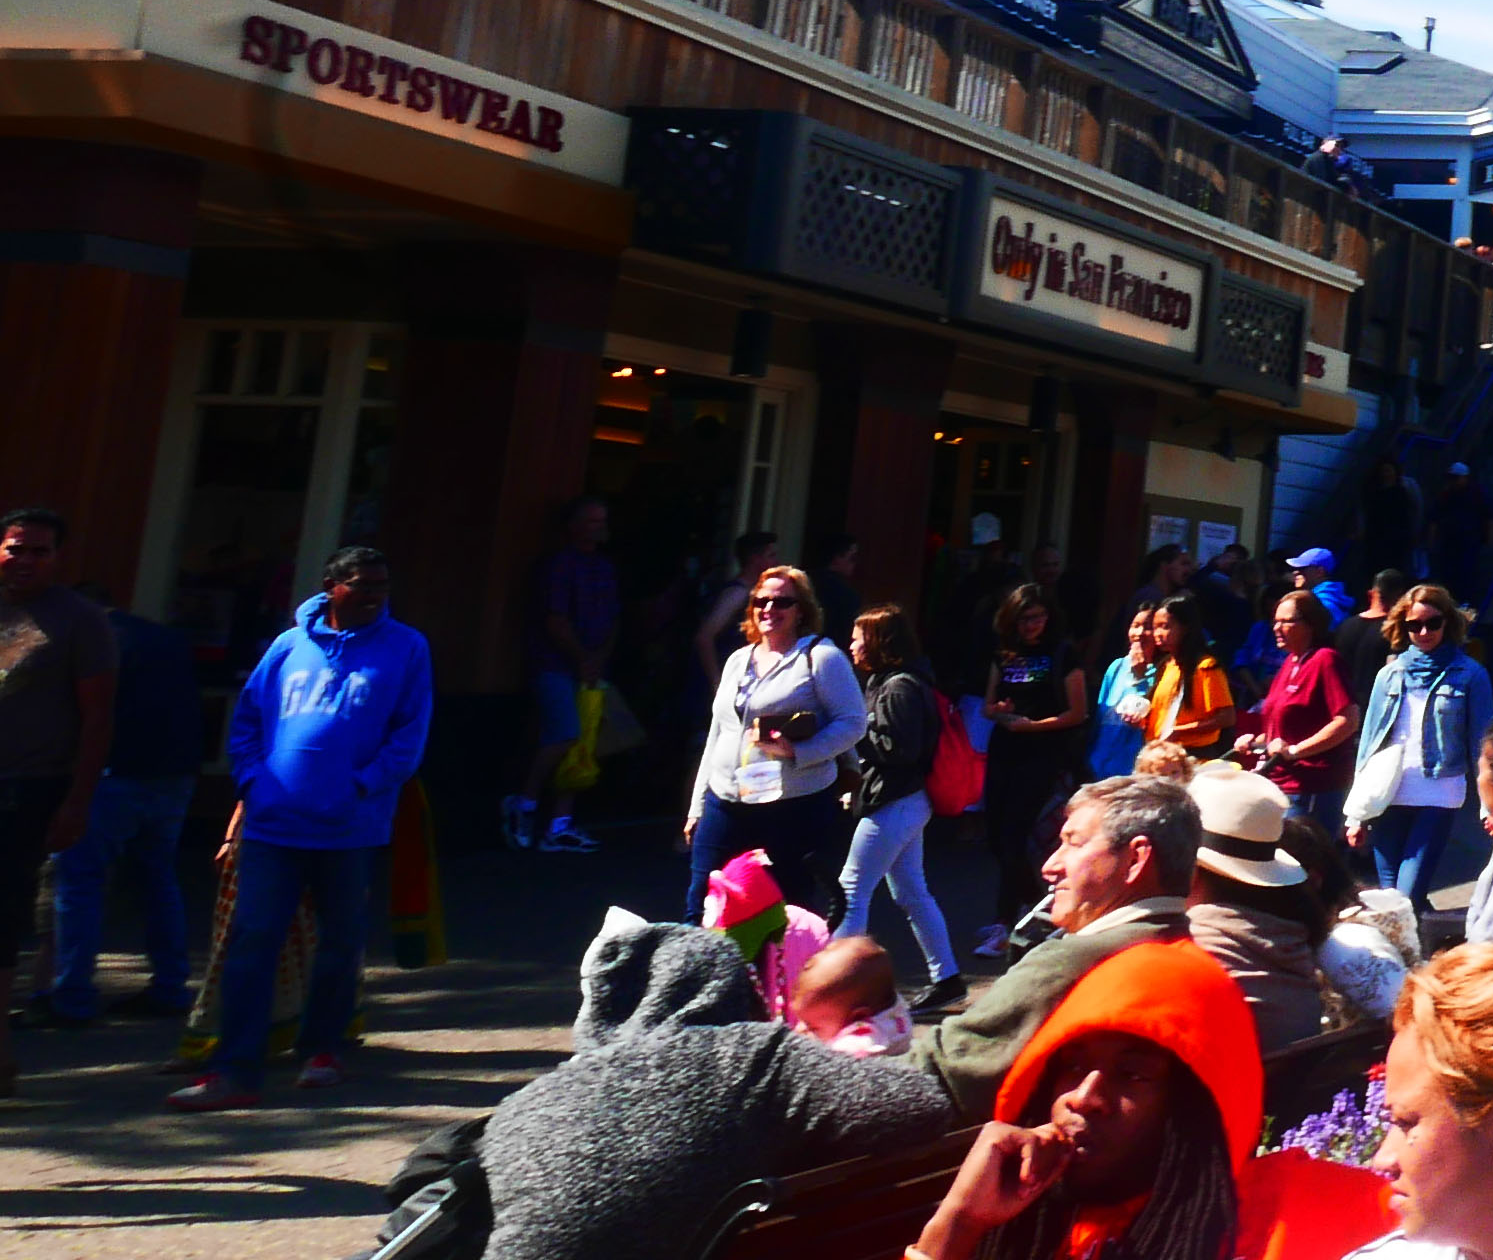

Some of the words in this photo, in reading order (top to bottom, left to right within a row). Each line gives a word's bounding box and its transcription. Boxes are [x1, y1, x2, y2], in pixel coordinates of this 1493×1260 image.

[239, 15, 565, 153] SPORTSWEAR
[992, 215, 1044, 301] Only
[1043, 232, 1069, 293] in
[1068, 241, 1107, 305] San
[1106, 254, 1194, 331] Francisco
[279, 669, 370, 720] GAP
